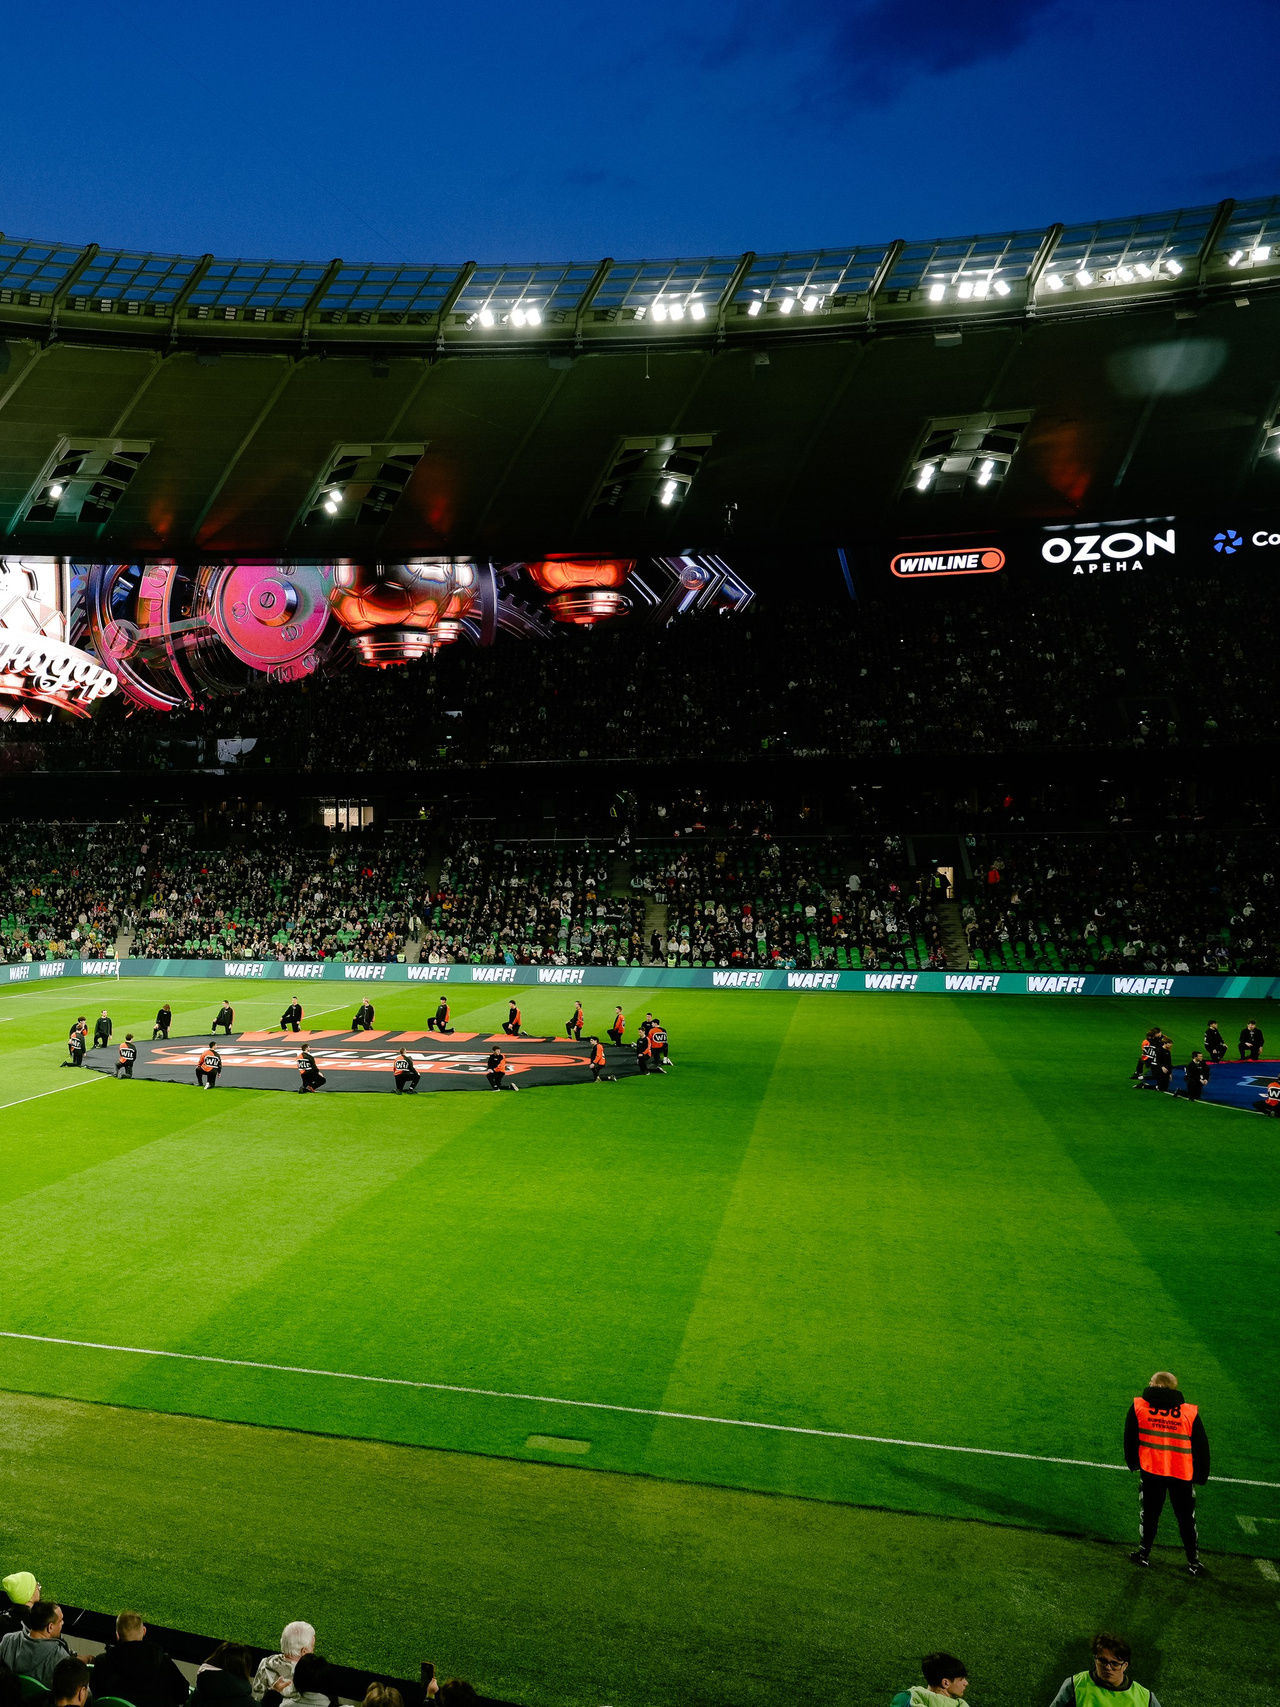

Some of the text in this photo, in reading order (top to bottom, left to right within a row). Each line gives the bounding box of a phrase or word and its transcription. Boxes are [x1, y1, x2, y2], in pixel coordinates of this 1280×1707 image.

[1041, 529, 1176, 564] OZON
[900, 554, 979, 573] WINLINE
[9, 965, 30, 980] WAFF!
[40, 962, 66, 977] WAFF!
[224, 963, 264, 977] WAFF!
[283, 964, 325, 978] WAFF!
[344, 966, 387, 980] WAFF!
[407, 967, 451, 981] WAFF!
[472, 968, 517, 982] WAFF!
[539, 969, 585, 984] WAFF!
[712, 972, 763, 987] WAFF!
[787, 973, 839, 988] WAFF!
[865, 974, 918, 990] WAFF!
[945, 975, 1001, 991] WAFF!
[1028, 977, 1086, 993] WAFF!
[1114, 978, 1174, 995] WAFF!
